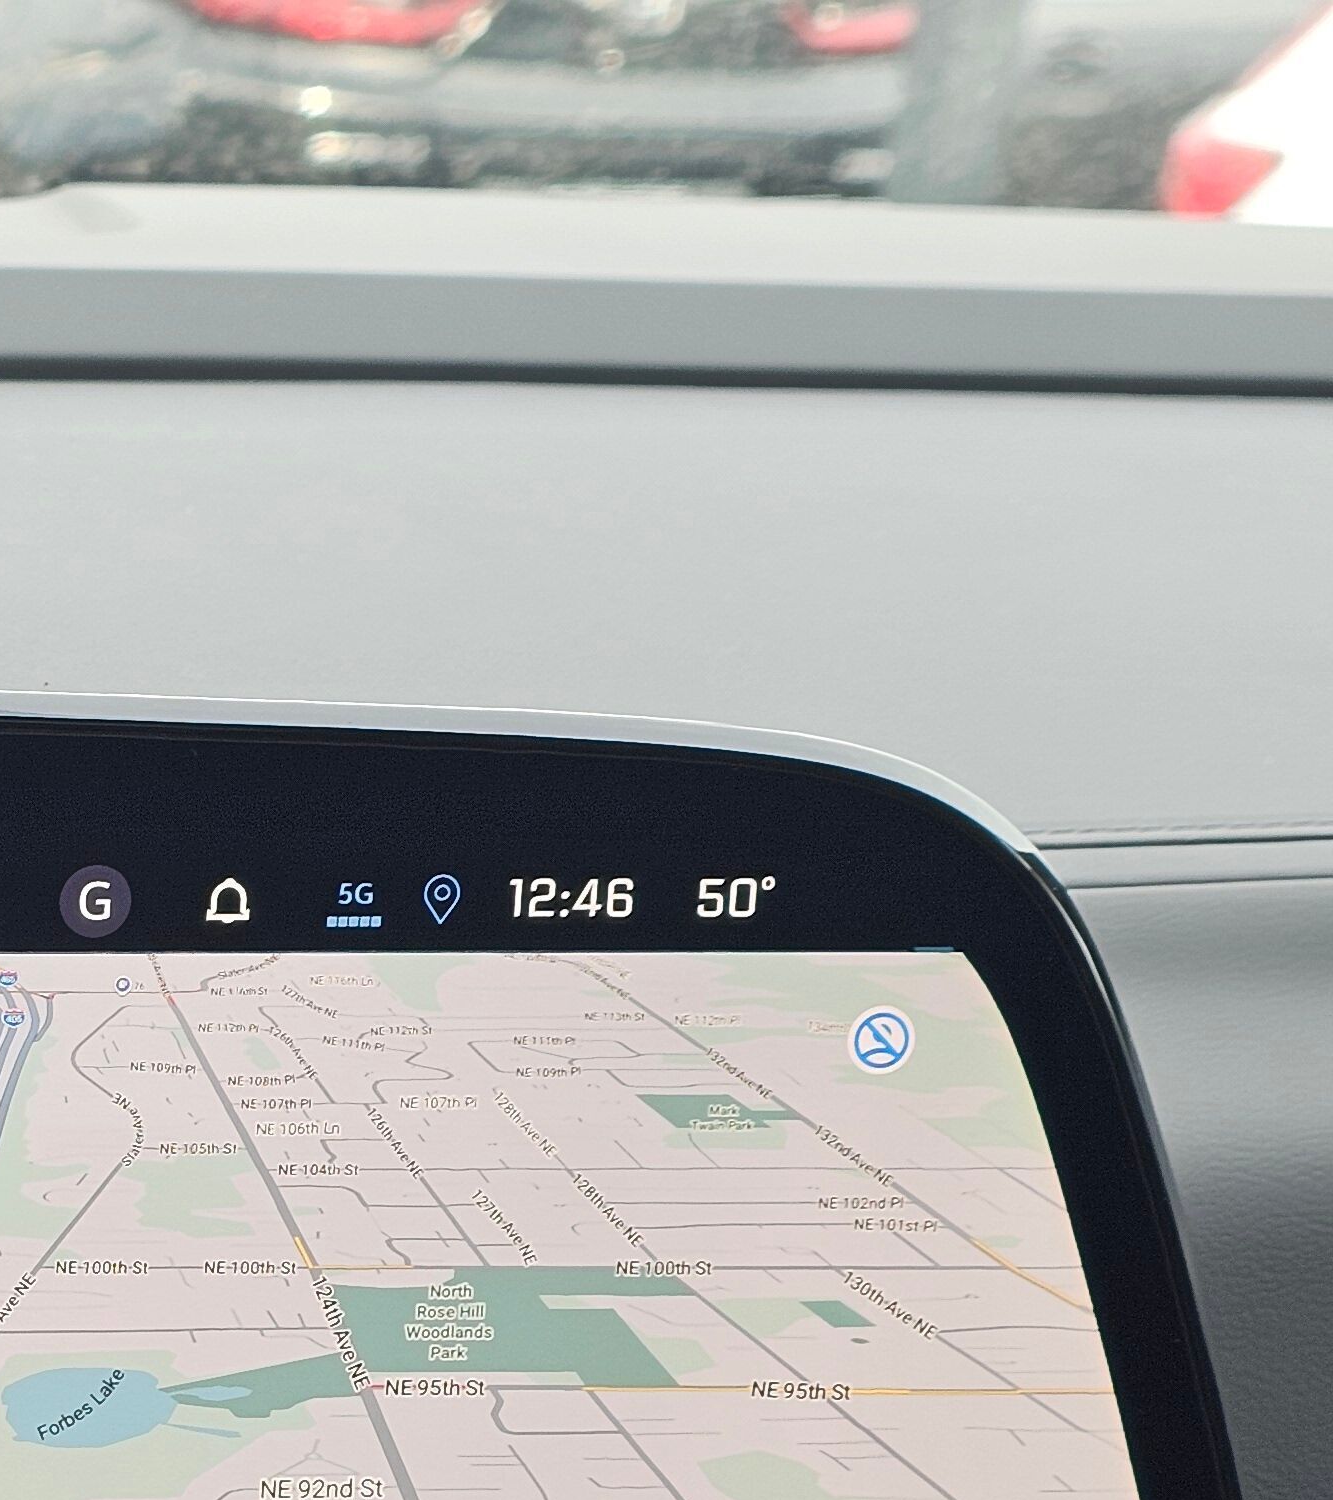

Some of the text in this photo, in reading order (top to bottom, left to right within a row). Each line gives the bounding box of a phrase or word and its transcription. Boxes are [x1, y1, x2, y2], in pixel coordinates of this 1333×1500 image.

[78, 881, 111, 921] G
[338, 883, 374, 905] 5G
[509, 878, 633, 919] 12:46
[695, 875, 776, 919] 50°
[205, 1262, 296, 1275] NE 100th St
[431, 1285, 472, 1298] North
[418, 1305, 484, 1318] Rose Hill
[310, 1276, 371, 1392] 124th Ave NE
[406, 1326, 493, 1339] Woodlands
[430, 1347, 466, 1359] Park
[752, 1382, 850, 1400] NE 95th St
[38, 1368, 125, 1439] Forbes Lake
[261, 1479, 383, 1498] NE 92nd St
